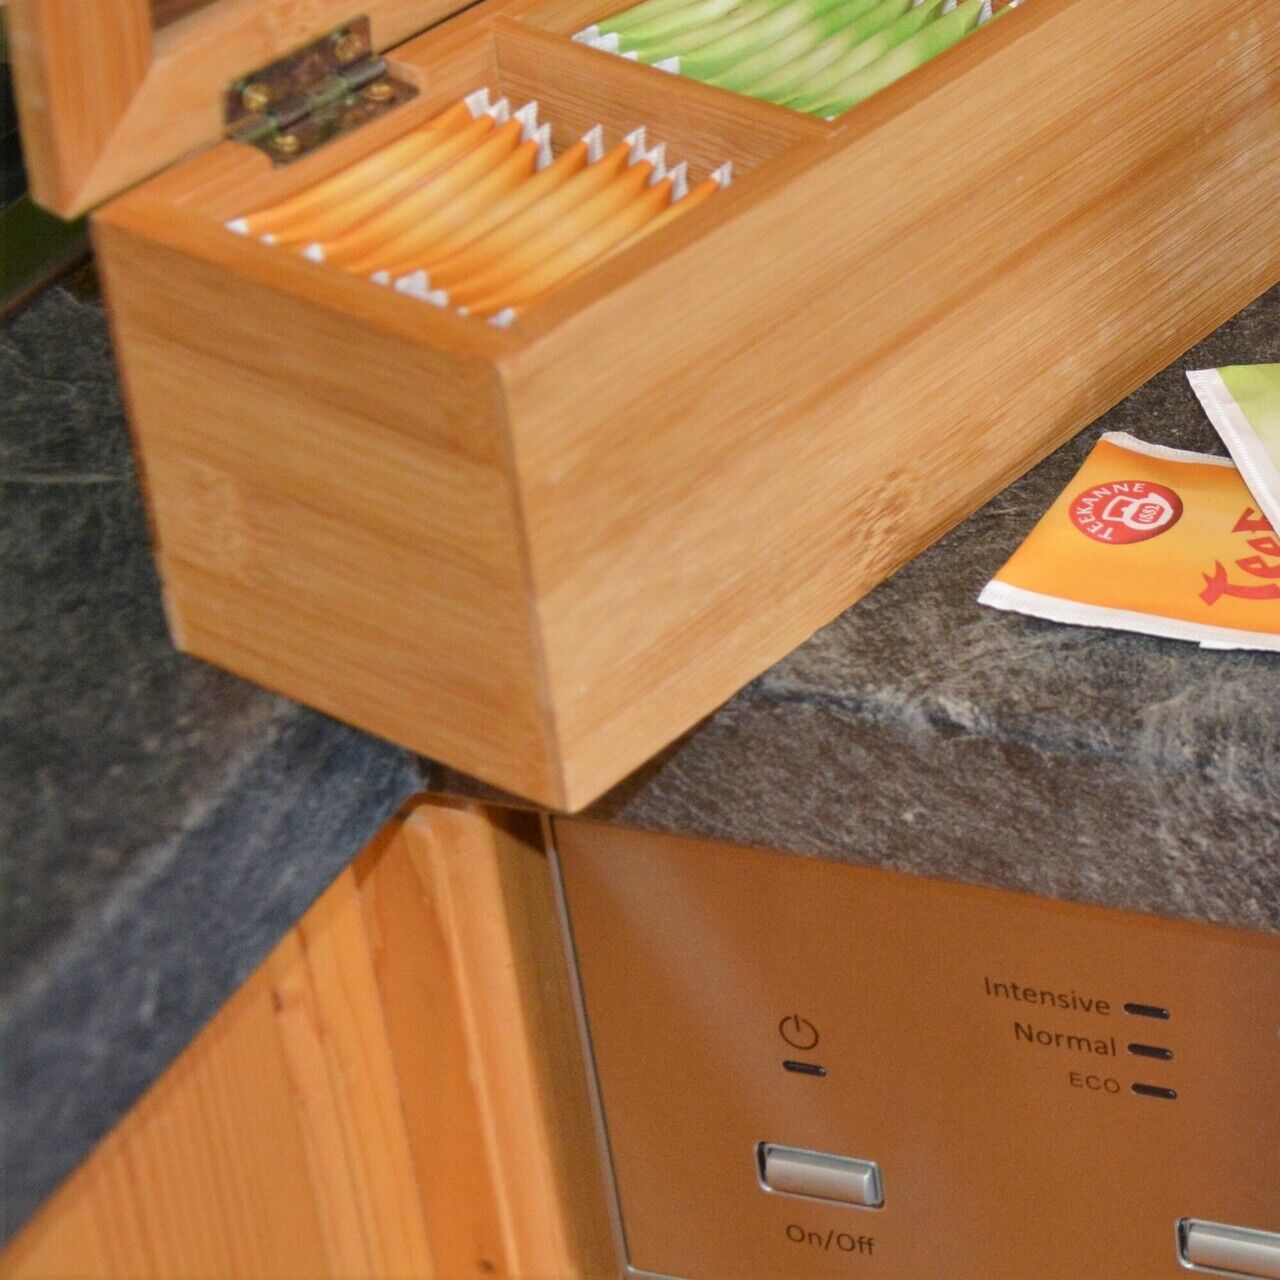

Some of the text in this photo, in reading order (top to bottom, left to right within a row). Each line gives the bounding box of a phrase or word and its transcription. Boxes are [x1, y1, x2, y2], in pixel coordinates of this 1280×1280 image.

[1076, 483, 1145, 540] TEEKANNE
[984, 977, 1110, 1015] Intensive
[1014, 1022, 1116, 1057] Normal
[1069, 1072, 1121, 1094] ECO
[786, 1225, 874, 1255] On/Off
